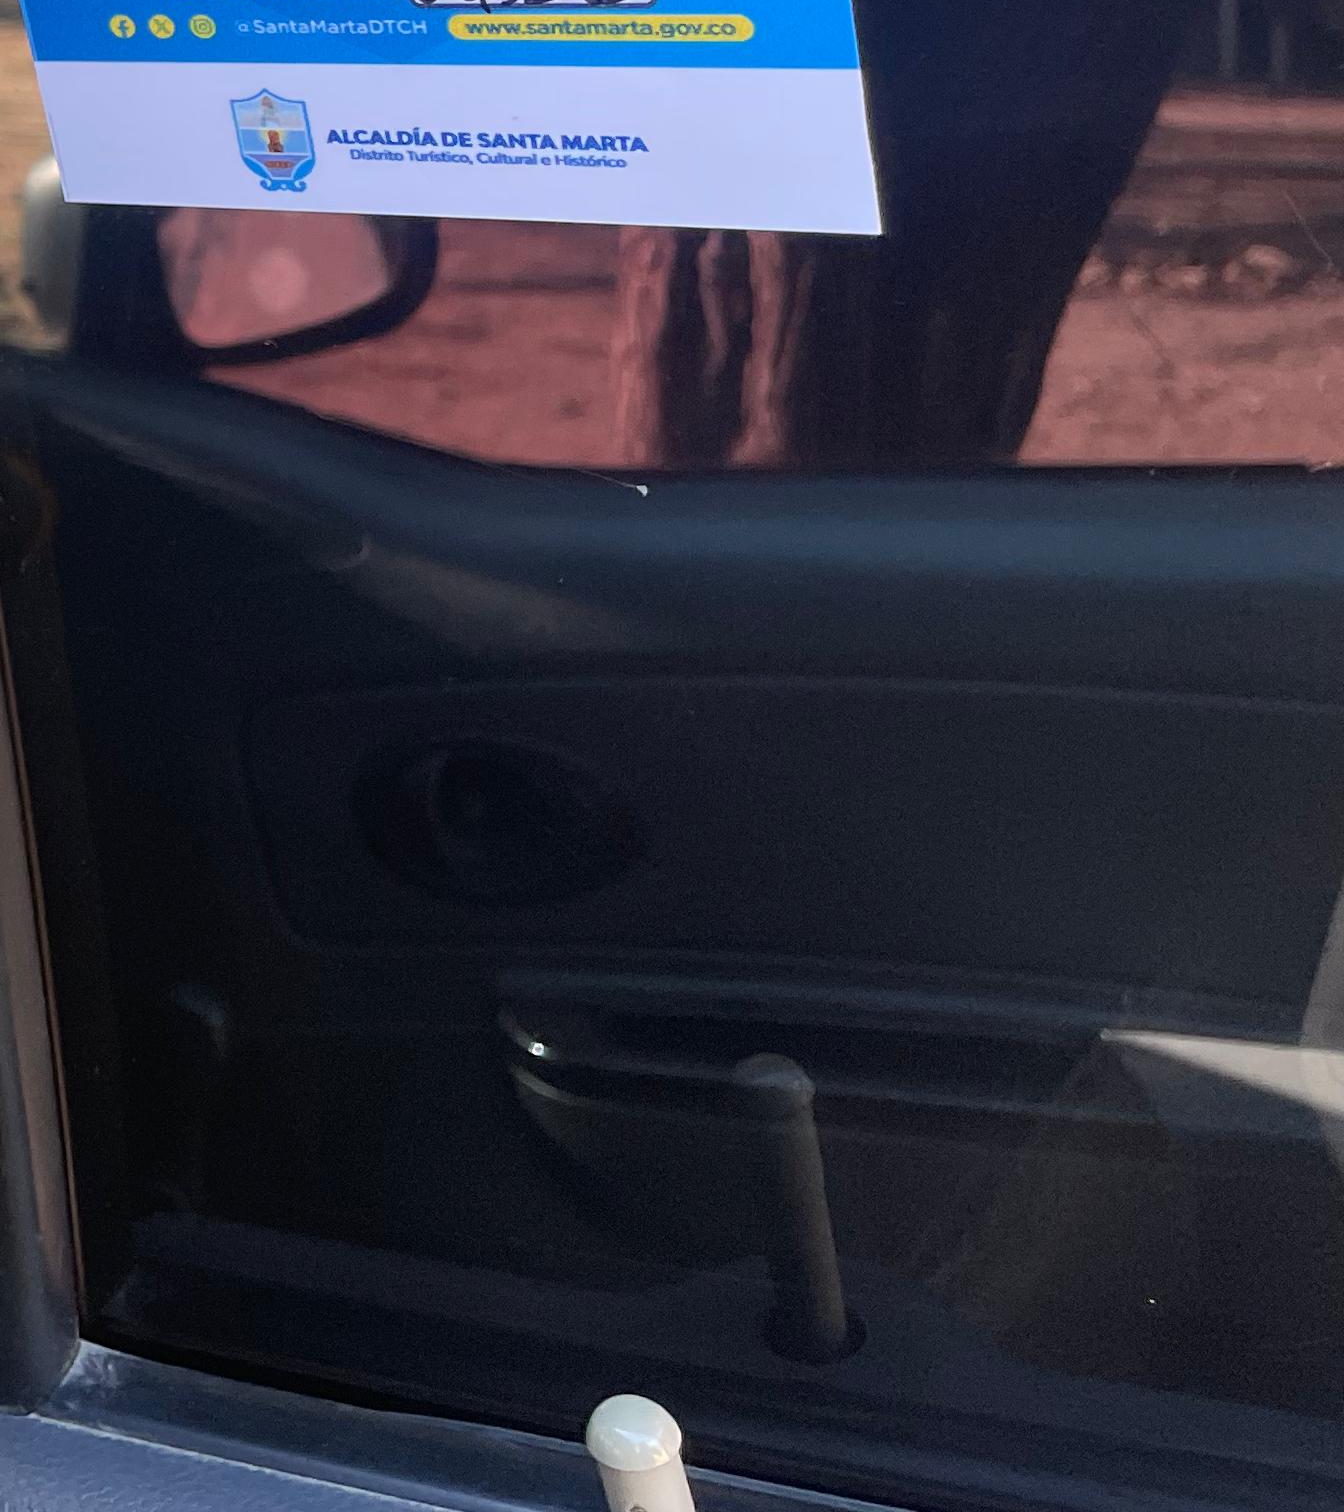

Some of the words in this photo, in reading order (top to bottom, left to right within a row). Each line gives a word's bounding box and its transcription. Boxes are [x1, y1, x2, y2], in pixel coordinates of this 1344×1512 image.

[465, 19, 736, 38] www.santamarta.gov.co
[326, 127, 437, 147] ALCALDÍA
[442, 131, 472, 148] DE
[478, 132, 558, 150] SANTA
[561, 135, 650, 153] MARTA
[350, 148, 403, 162] Distrito
[476, 151, 537, 166] Cultural
[555, 153, 627, 168] Histórico
